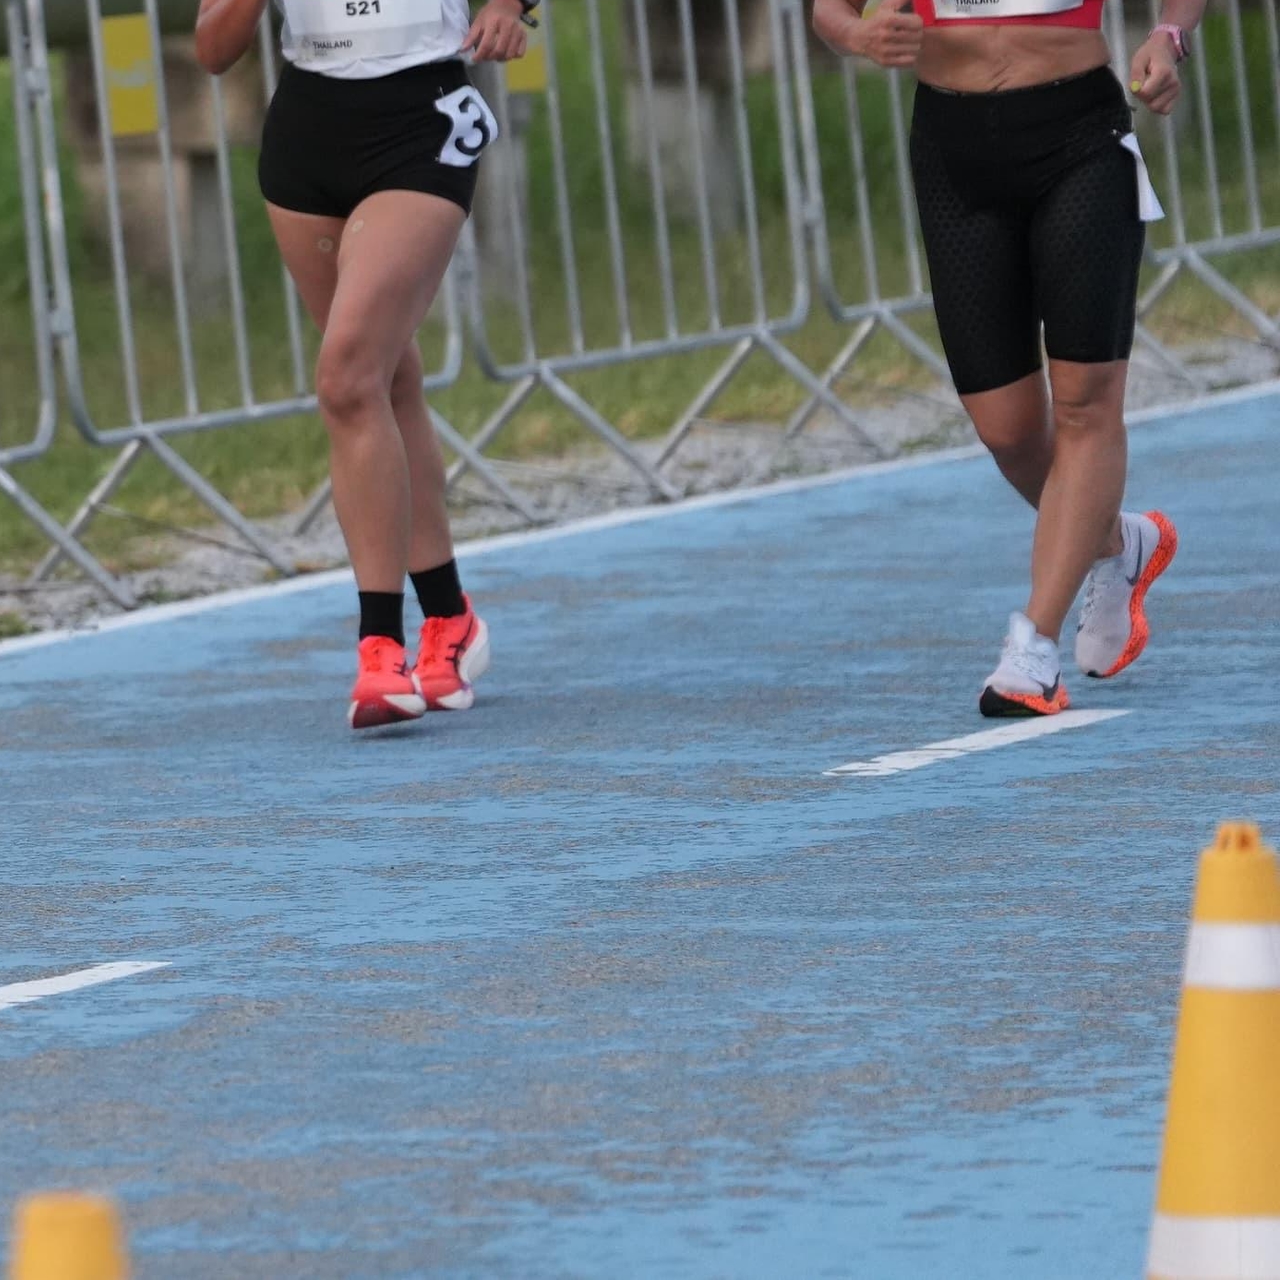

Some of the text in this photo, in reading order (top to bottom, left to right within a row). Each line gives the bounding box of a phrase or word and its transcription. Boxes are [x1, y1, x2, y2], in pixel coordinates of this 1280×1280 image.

[345, 0, 381, 17] 521
[312, 39, 353, 50] THAILAND
[454, 95, 490, 156] 3
